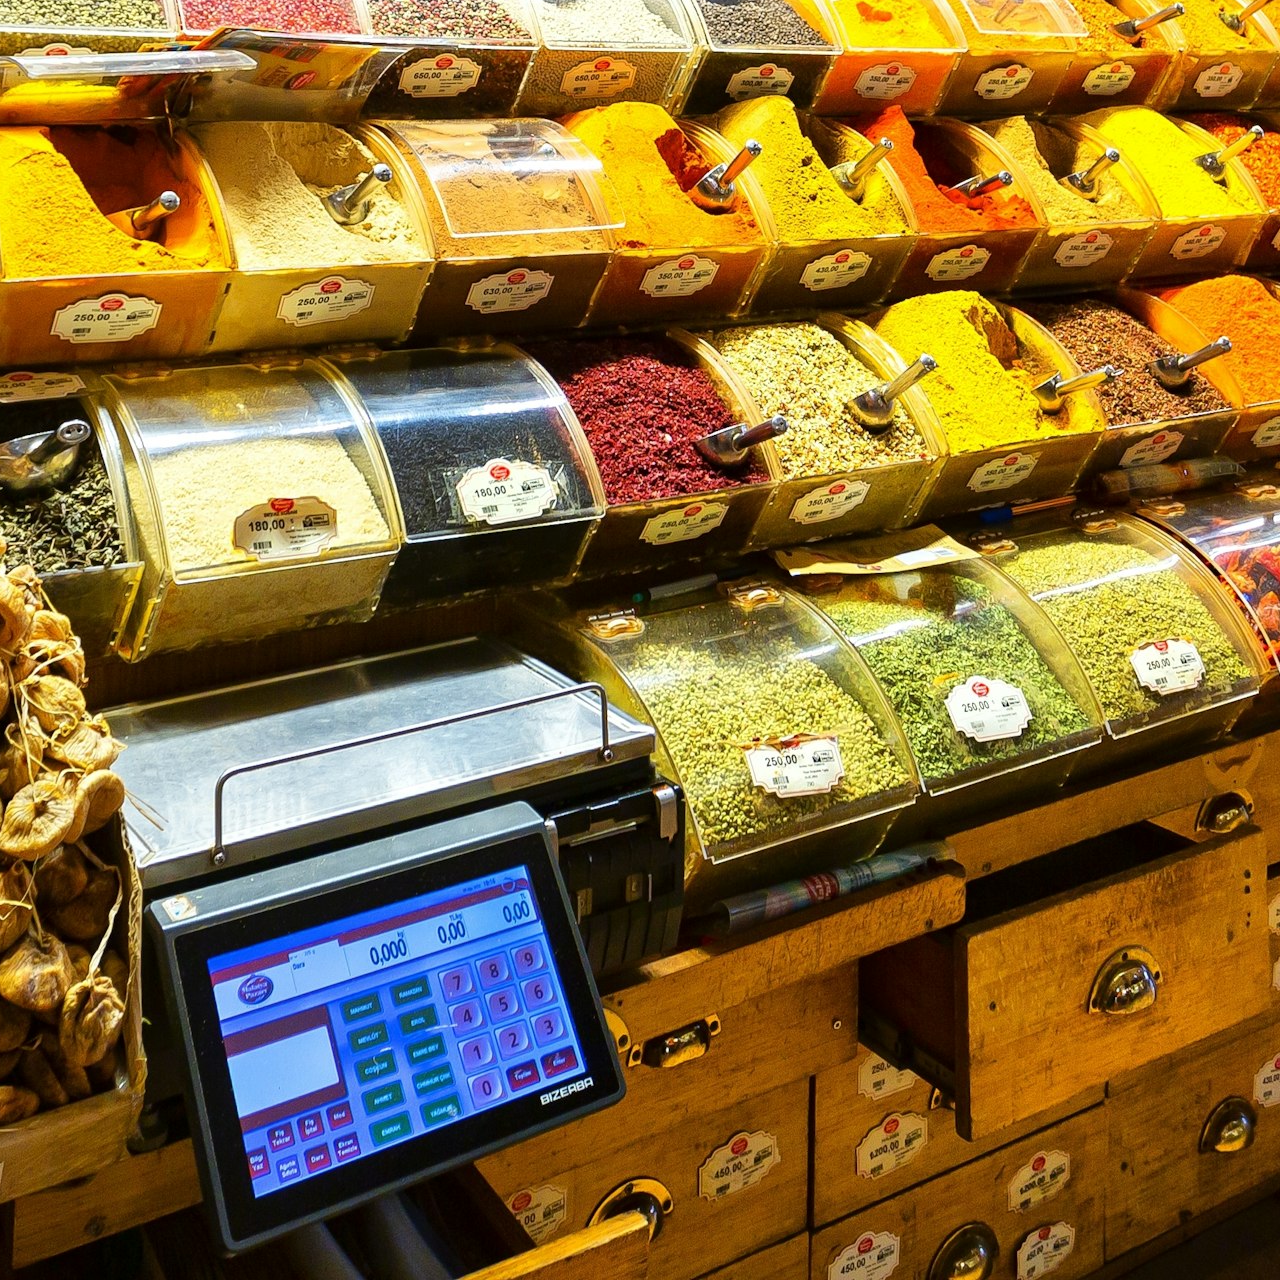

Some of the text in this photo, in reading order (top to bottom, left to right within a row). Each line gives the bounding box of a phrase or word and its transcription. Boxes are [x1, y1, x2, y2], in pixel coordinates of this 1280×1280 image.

[413, 71, 442, 80] 650,00
[574, 73, 600, 82] 650,00
[815, 265, 839, 274] 430,00
[482, 286, 513, 297] 630,00
[296, 295, 330, 307] 250,00
[72, 312, 111, 322] 250,00
[474, 484, 507, 500] 180,00
[807, 496, 834, 507] 350,00
[247, 518, 286, 534] 180,00
[1146, 657, 1171, 671] 250,00
[961, 699, 990, 714] 250,00
[764, 753, 798, 769] 250,00
[503, 900, 530, 923] 0,00
[438, 921, 466, 944] 0,00
[370, 938, 407, 966] 0,000
[524, 952, 534, 967] 9
[293, 962, 305, 971] Dara
[489, 964, 499, 978] 8
[453, 975, 461, 990] 7
[534, 985, 544, 999] 6
[499, 996, 508, 1012] 5
[463, 1009, 473, 1023] 4
[544, 1020, 554, 1035] 3
[508, 1033, 519, 1048] 2
[473, 1045, 482, 1060] 1
[482, 1081, 491, 1096] 0
[540, 1077, 594, 1106] BIZERBA
[374, 1093, 392, 1105] AHMET
[381, 1124, 401, 1137] EMRAH
[311, 1155, 324, 1163] Dara
[839, 1257, 867, 1275] 450,00
